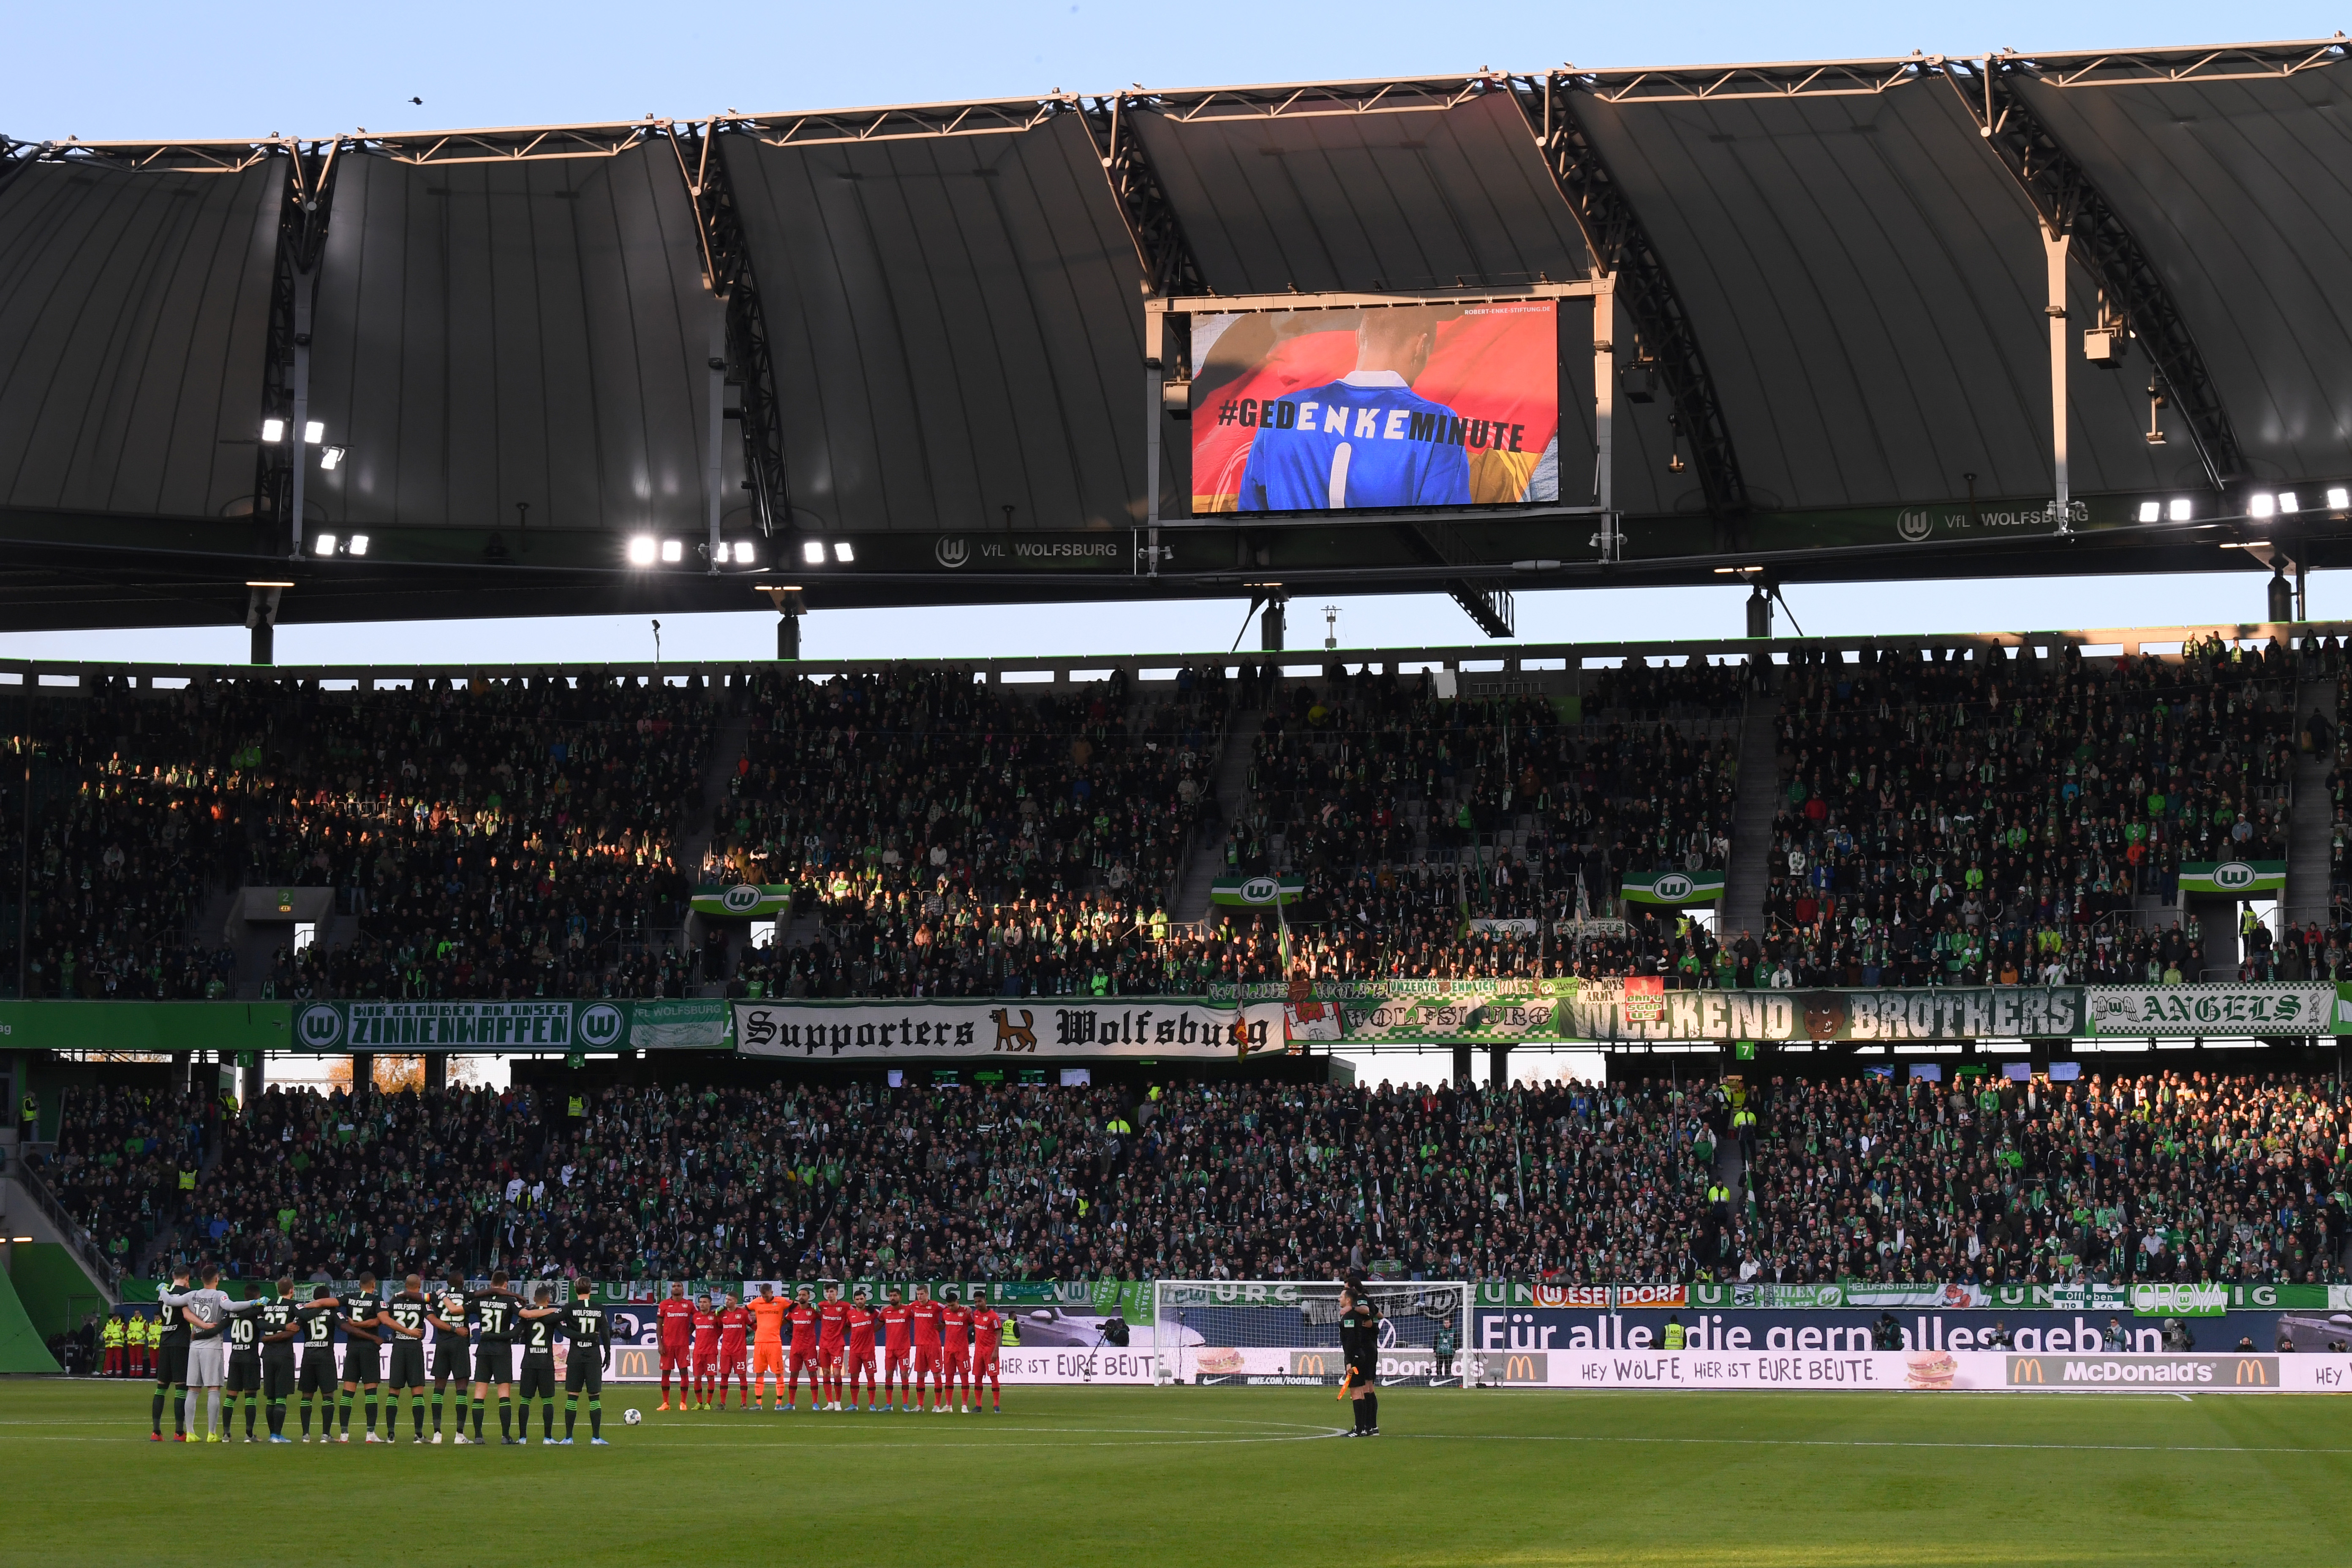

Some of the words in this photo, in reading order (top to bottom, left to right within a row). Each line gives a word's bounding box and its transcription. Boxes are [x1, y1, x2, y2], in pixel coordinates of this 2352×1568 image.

[1464, 306, 1551, 316] ROBERT-ENKE-STIFTUNG.DE
[1217, 398, 1525, 453] #GEDENKEMINUTE
[981, 544, 1005, 557] VfL
[1015, 543, 1117, 556] WOLFSBURG
[283, 893, 289, 902] 2
[1585, 990, 1615, 1002] ARMY
[354, 1006, 386, 1016] WIR
[392, 1005, 475, 1016] GLAUBEN
[487, 1005, 504, 1016] AN
[510, 1004, 568, 1015] UNSER
[654, 1004, 721, 1017] WOLFSBURG
[1850, 989, 2074, 1039] BROTHERS
[2142, 995, 2302, 1022] ANGELS
[351, 1017, 570, 1043] ZINNENWAPPEN
[745, 1010, 975, 1056] Supporters
[1742, 1046, 1749, 1056] 7
[1538, 1283, 1680, 1306] WESENDORF
[2066, 1292, 2113, 1301] Offleben
[2134, 1284, 2226, 1313] CROYA
[348, 1298, 373, 1307] WOLFSBURG
[479, 1301, 507, 1309] WOLFSBURG
[193, 1303, 212, 1323] 12
[393, 1310, 420, 1333] 32
[481, 1308, 503, 1334] 31
[578, 1317, 596, 1334] 11
[230, 1319, 253, 1343] 40
[307, 1315, 328, 1341] 15
[531, 1321, 546, 1346] 2
[1482, 1313, 1557, 1349] Für
[1685, 1314, 1752, 1350] die
[736, 1361, 745, 1369] 23
[807, 1358, 817, 1367] 38
[833, 1356, 841, 1364] 29
[867, 1360, 875, 1369] 31
[902, 1358, 909, 1366] 10
[935, 1359, 940, 1368] 5
[963, 1360, 969, 1368] 11
[707, 1363, 716, 1372] 20
[988, 1363, 995, 1371] 18
[1582, 1363, 1607, 1382] HEY
[1613, 1357, 1685, 1383] WÖLFE,
[1758, 1358, 1802, 1382] EURE
[1809, 1358, 1878, 1382] BEUTE.
[2063, 1361, 2213, 1382] McDonald's
[1247, 1377, 1323, 1386] NIKE.COM/FOOTBALL
[2316, 1367, 2342, 1386] HEY
